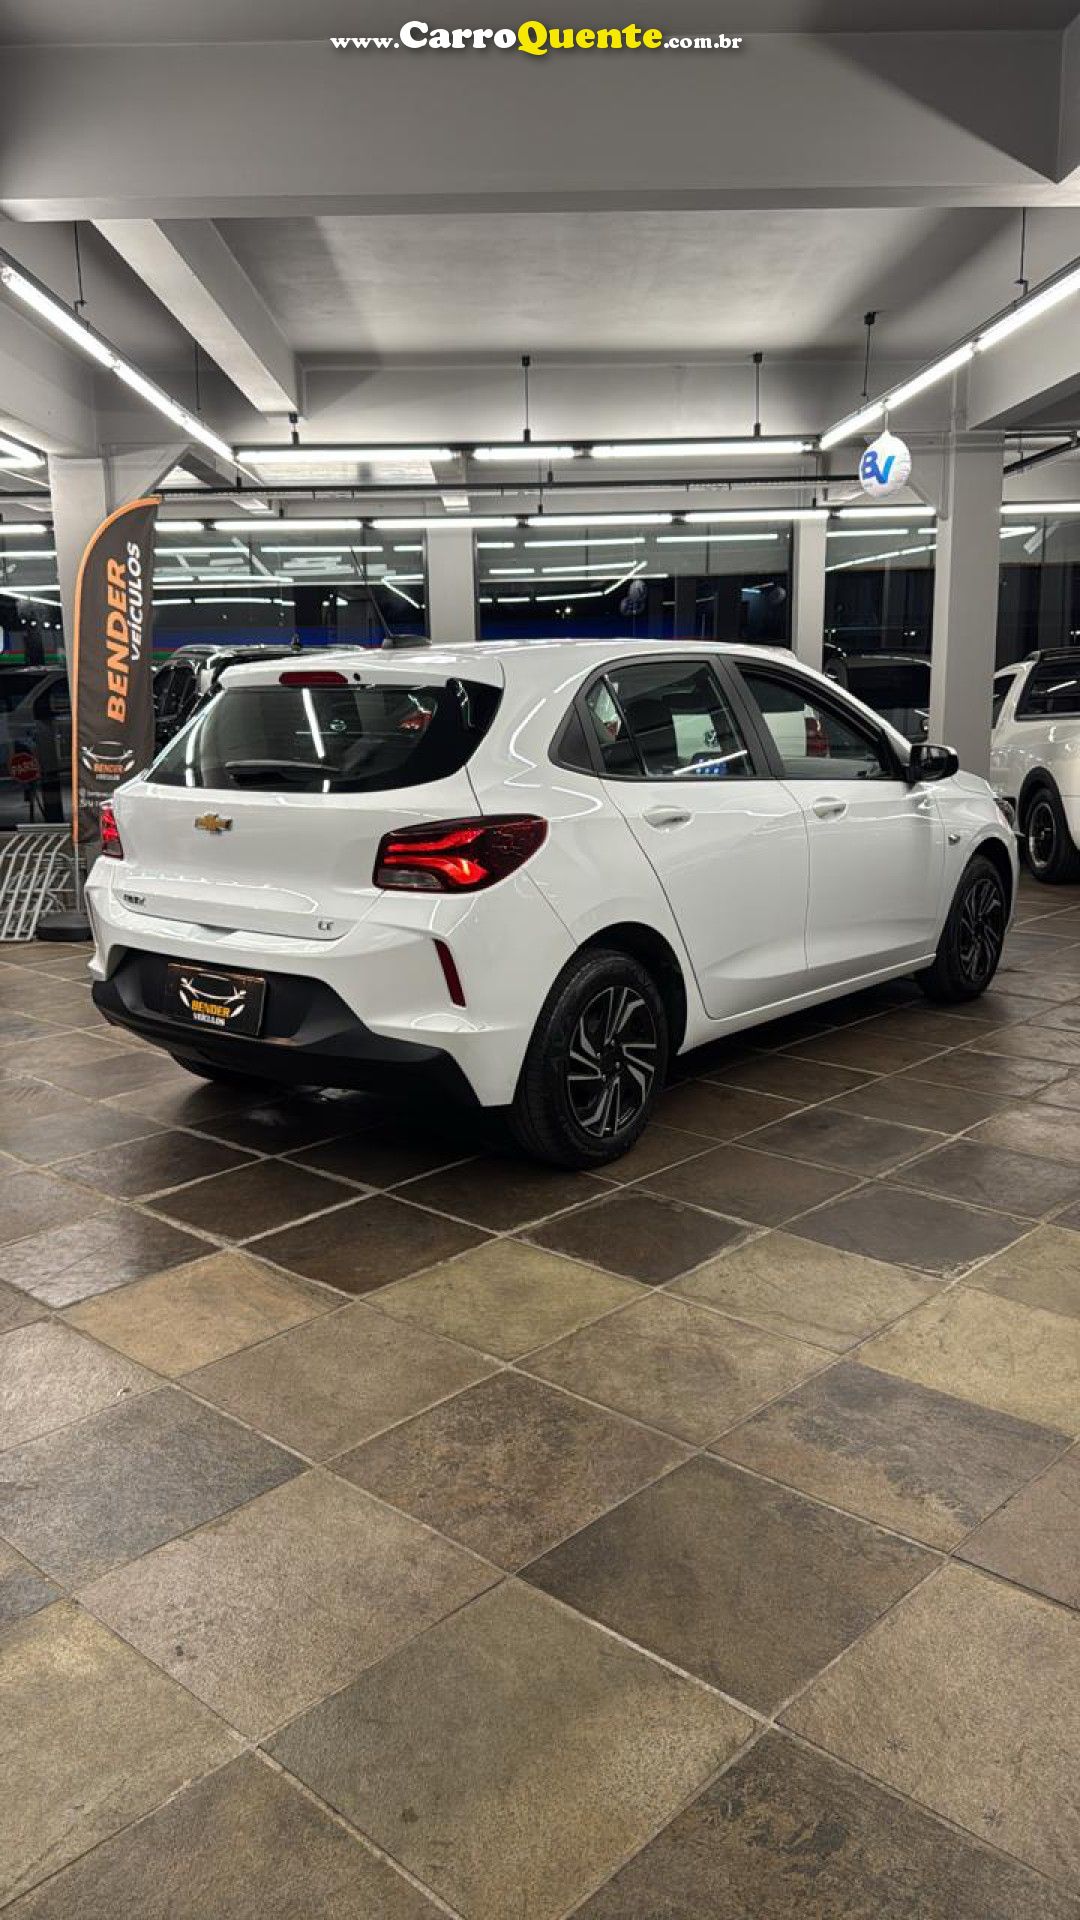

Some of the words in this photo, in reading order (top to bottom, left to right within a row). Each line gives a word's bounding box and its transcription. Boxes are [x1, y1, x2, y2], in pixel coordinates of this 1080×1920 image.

[862, 450, 896, 484] BV
[127, 541, 143, 661] VEÍCULOS
[106, 557, 129, 723] BENDER
[191, 1000, 231, 1018] BENDER
